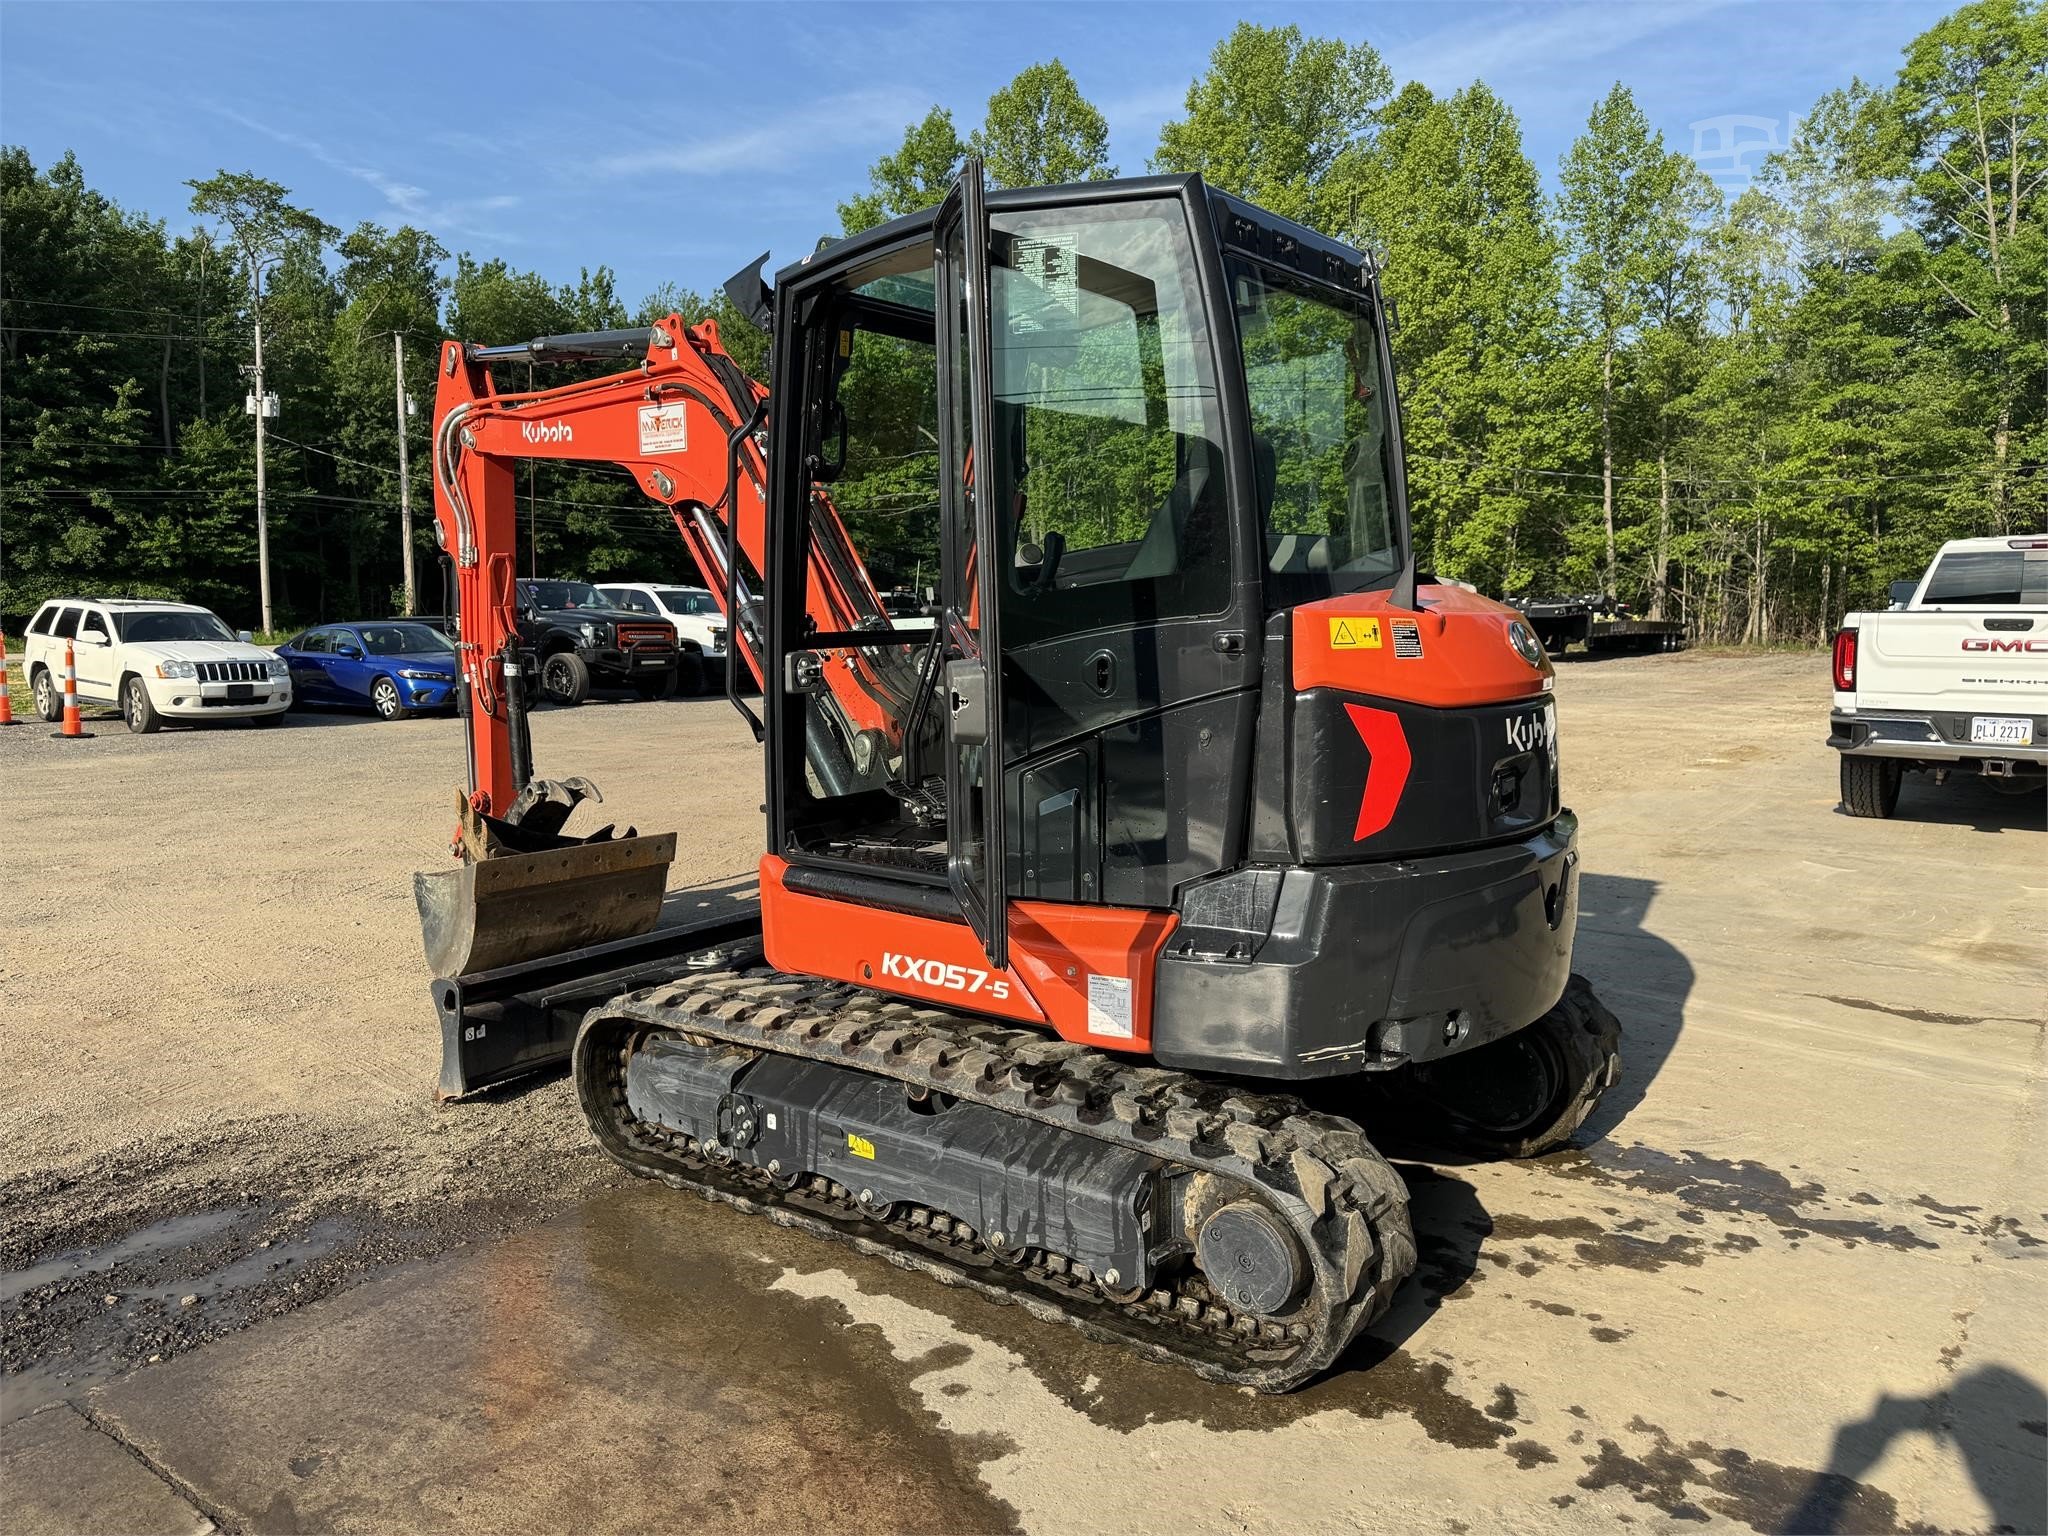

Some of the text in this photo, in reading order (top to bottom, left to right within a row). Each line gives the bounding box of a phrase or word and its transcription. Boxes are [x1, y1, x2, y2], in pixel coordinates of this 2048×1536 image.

[522, 420, 573, 443] Kubota
[1961, 638, 2048, 652] GMC
[1975, 724, 2027, 739] PLJ 2217
